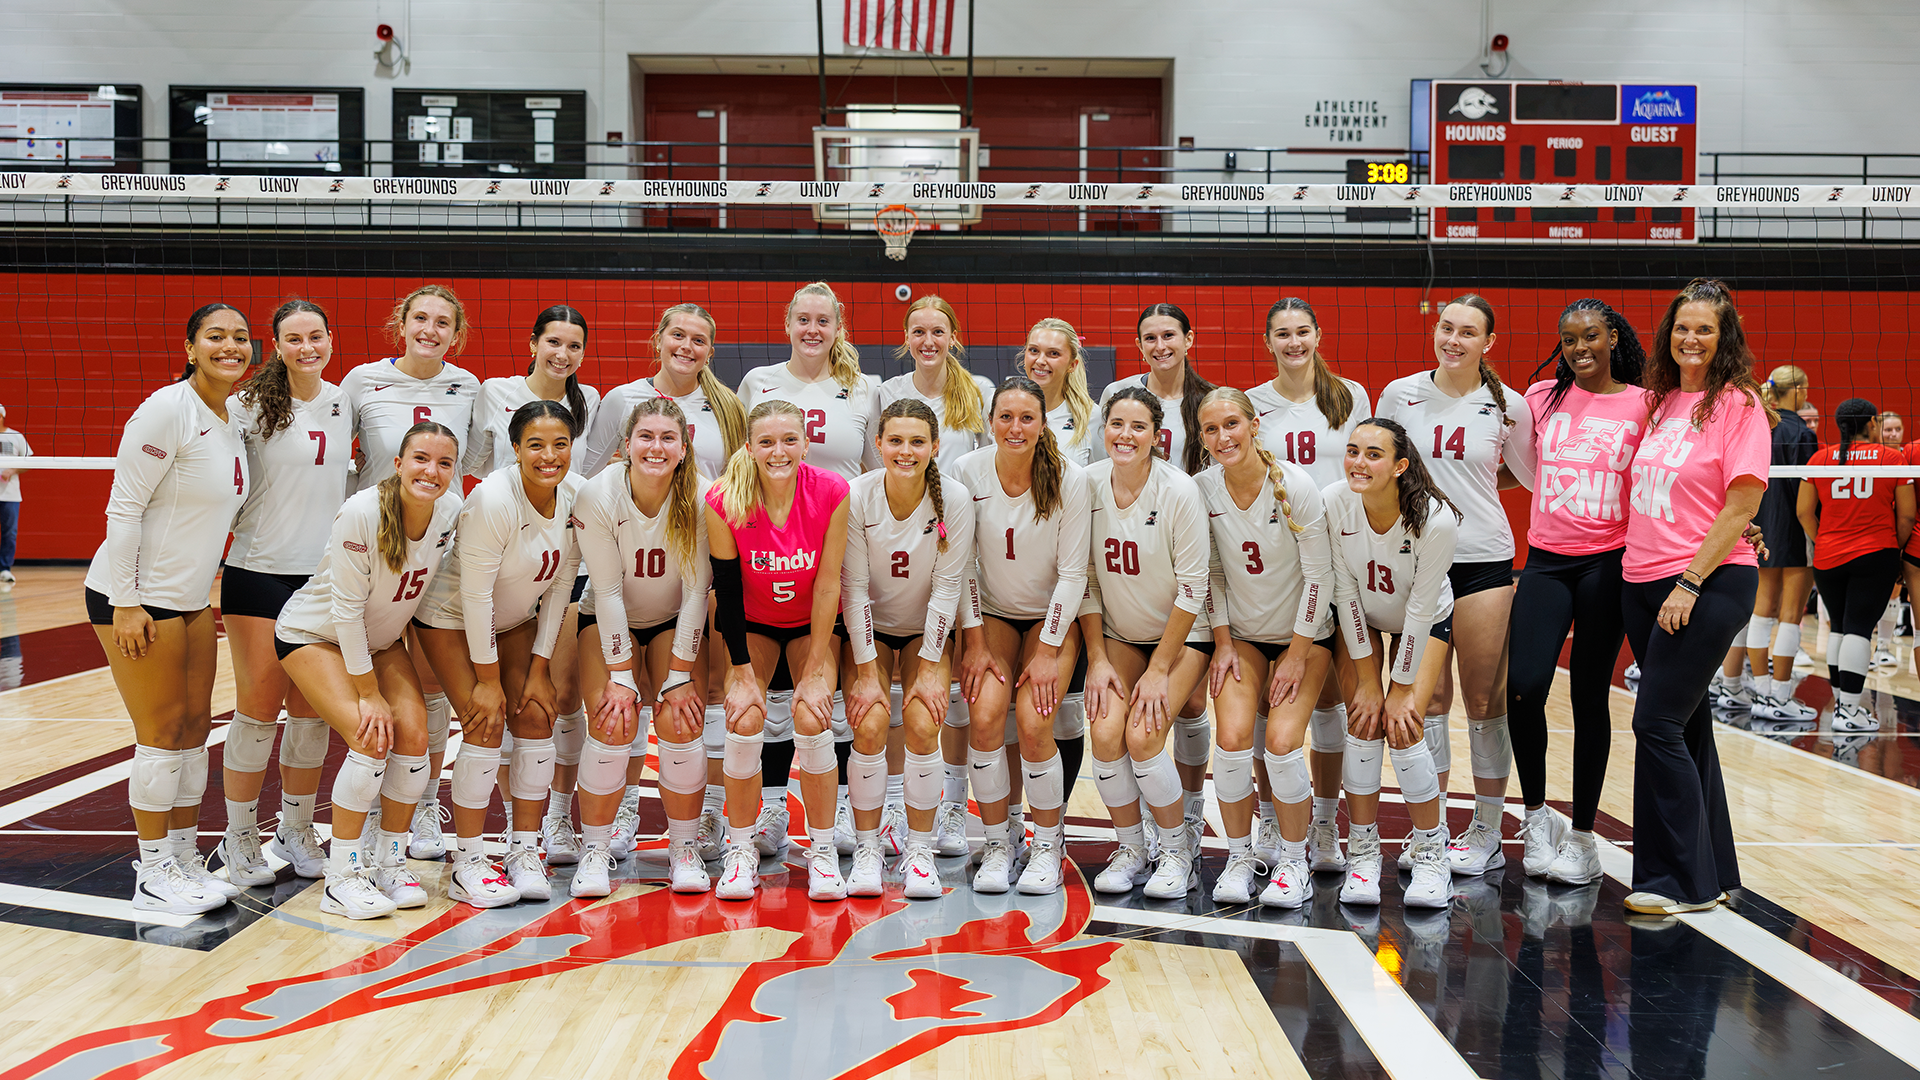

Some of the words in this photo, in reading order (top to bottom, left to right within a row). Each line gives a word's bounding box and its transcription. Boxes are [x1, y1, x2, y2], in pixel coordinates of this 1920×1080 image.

[1305, 115, 1387, 128] ENDOWMENT
[1315, 101, 1378, 113] ATHLETIC
[1632, 98, 1682, 120] AQUAFINA
[1329, 130, 1363, 142] FUND
[1445, 125, 1506, 141] HOUNDS
[1547, 137, 1583, 149] PERIOD
[1631, 126, 1678, 142] GUEST
[0, 174, 26, 189] NDY
[101, 174, 186, 191] GREYHOUNDS
[259, 176, 299, 193] UINDY
[373, 178, 457, 195] GREYHOUNDS
[530, 180, 570, 196] UINDY
[644, 181, 728, 197] GREYHOUNDS
[800, 182, 840, 198] UINDY
[913, 183, 996, 199] GREYHOUNDS
[1069, 184, 1109, 200] UINDY
[1181, 186, 1265, 201] GREYHOUNDS
[1337, 186, 1376, 201] UINDY
[1450, 186, 1532, 201] GREYHOUNDS
[1605, 186, 1644, 202] UINDY
[1717, 187, 1800, 202] GREYHOUNDS
[1872, 187, 1911, 202] UINDY
[1367, 163, 1408, 184] 3:08
[1446, 226, 1479, 238] SCORE
[1549, 227, 1583, 239] MATCH
[1650, 227, 1682, 239] SCORE
[799, 408, 826, 445] 2
[308, 430, 327, 465] 7
[1285, 430, 1316, 465] 18
[1432, 425, 1466, 460] 14
[1832, 449, 1879, 461] MYVILLE
[233, 456, 244, 495] 4
[1831, 476, 1874, 499] 20
[1005, 527, 1016, 561] 1
[1104, 537, 1141, 576] 20
[1242, 541, 1264, 575] 3
[532, 549, 561, 582] 11
[634, 548, 666, 578] 10
[891, 550, 910, 579] 2
[1367, 559, 1396, 595] 13
[391, 567, 428, 602] 15
[772, 580, 796, 604] 5
[969, 578, 981, 620] NDIANAPOLIS
[1350, 600, 1366, 645] INDIANAPOLIS
[1402, 634, 1415, 673] GREYHOUNDS
